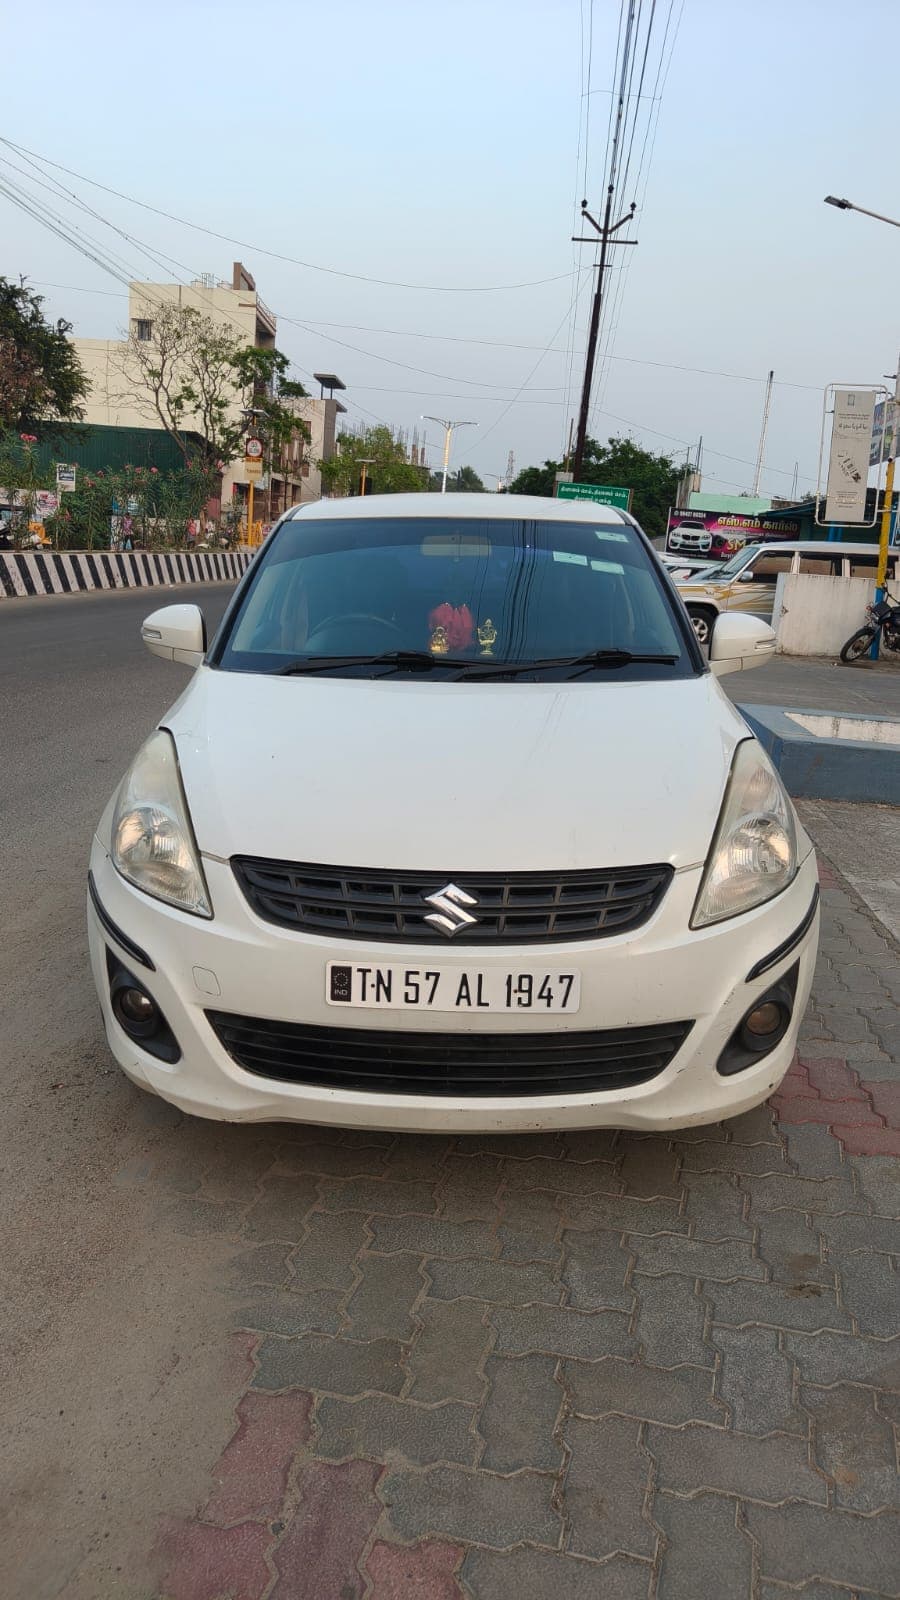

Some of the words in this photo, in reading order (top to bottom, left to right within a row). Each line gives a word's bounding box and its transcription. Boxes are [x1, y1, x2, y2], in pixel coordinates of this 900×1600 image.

[727, 538, 746, 551] SM
[334, 988, 348, 996] IND
[357, 968, 392, 1002] TN
[404, 970, 440, 1004] 57
[455, 973, 489, 1007] AL
[506, 974, 574, 1008] 1947
